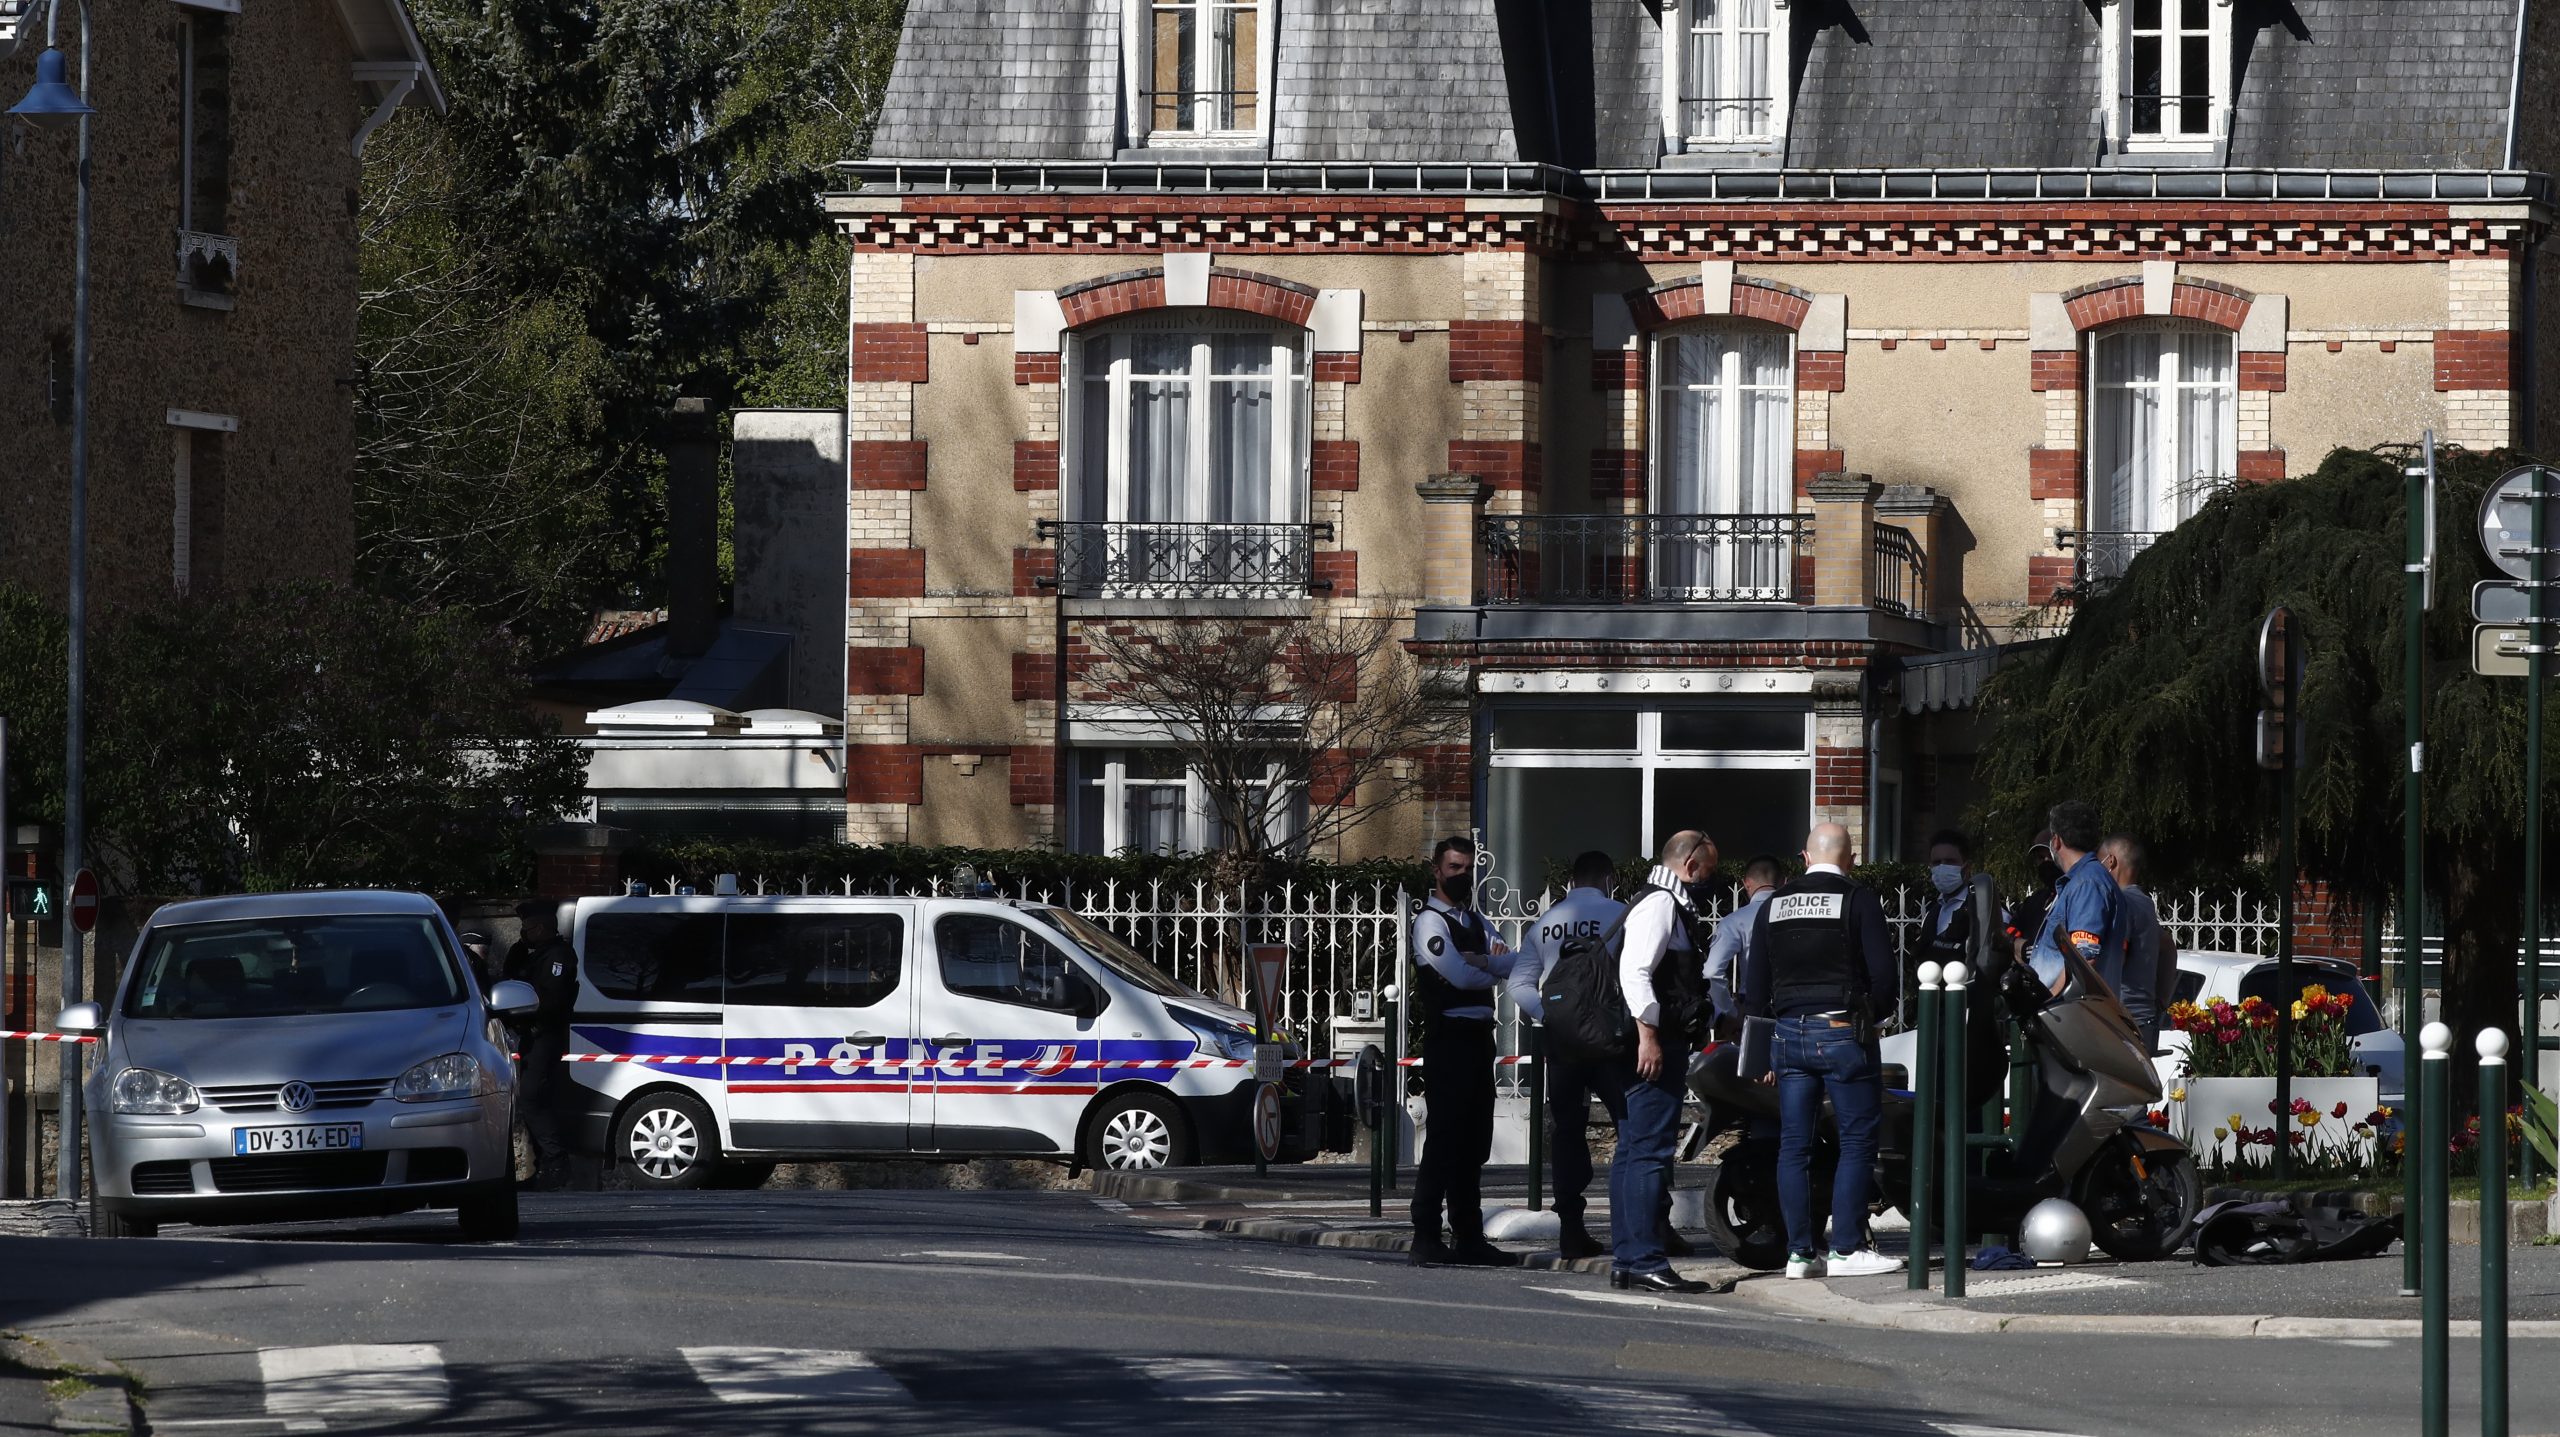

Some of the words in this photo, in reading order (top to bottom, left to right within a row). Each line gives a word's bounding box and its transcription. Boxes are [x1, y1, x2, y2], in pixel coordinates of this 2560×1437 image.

[1776, 907, 1832, 919] JUDICIAIRE
[1781, 895, 1830, 910] POLICE
[1542, 920, 1601, 944] POLICE
[784, 1042, 1003, 1077] POLICE
[250, 1127, 350, 1151] DV-314-ED
